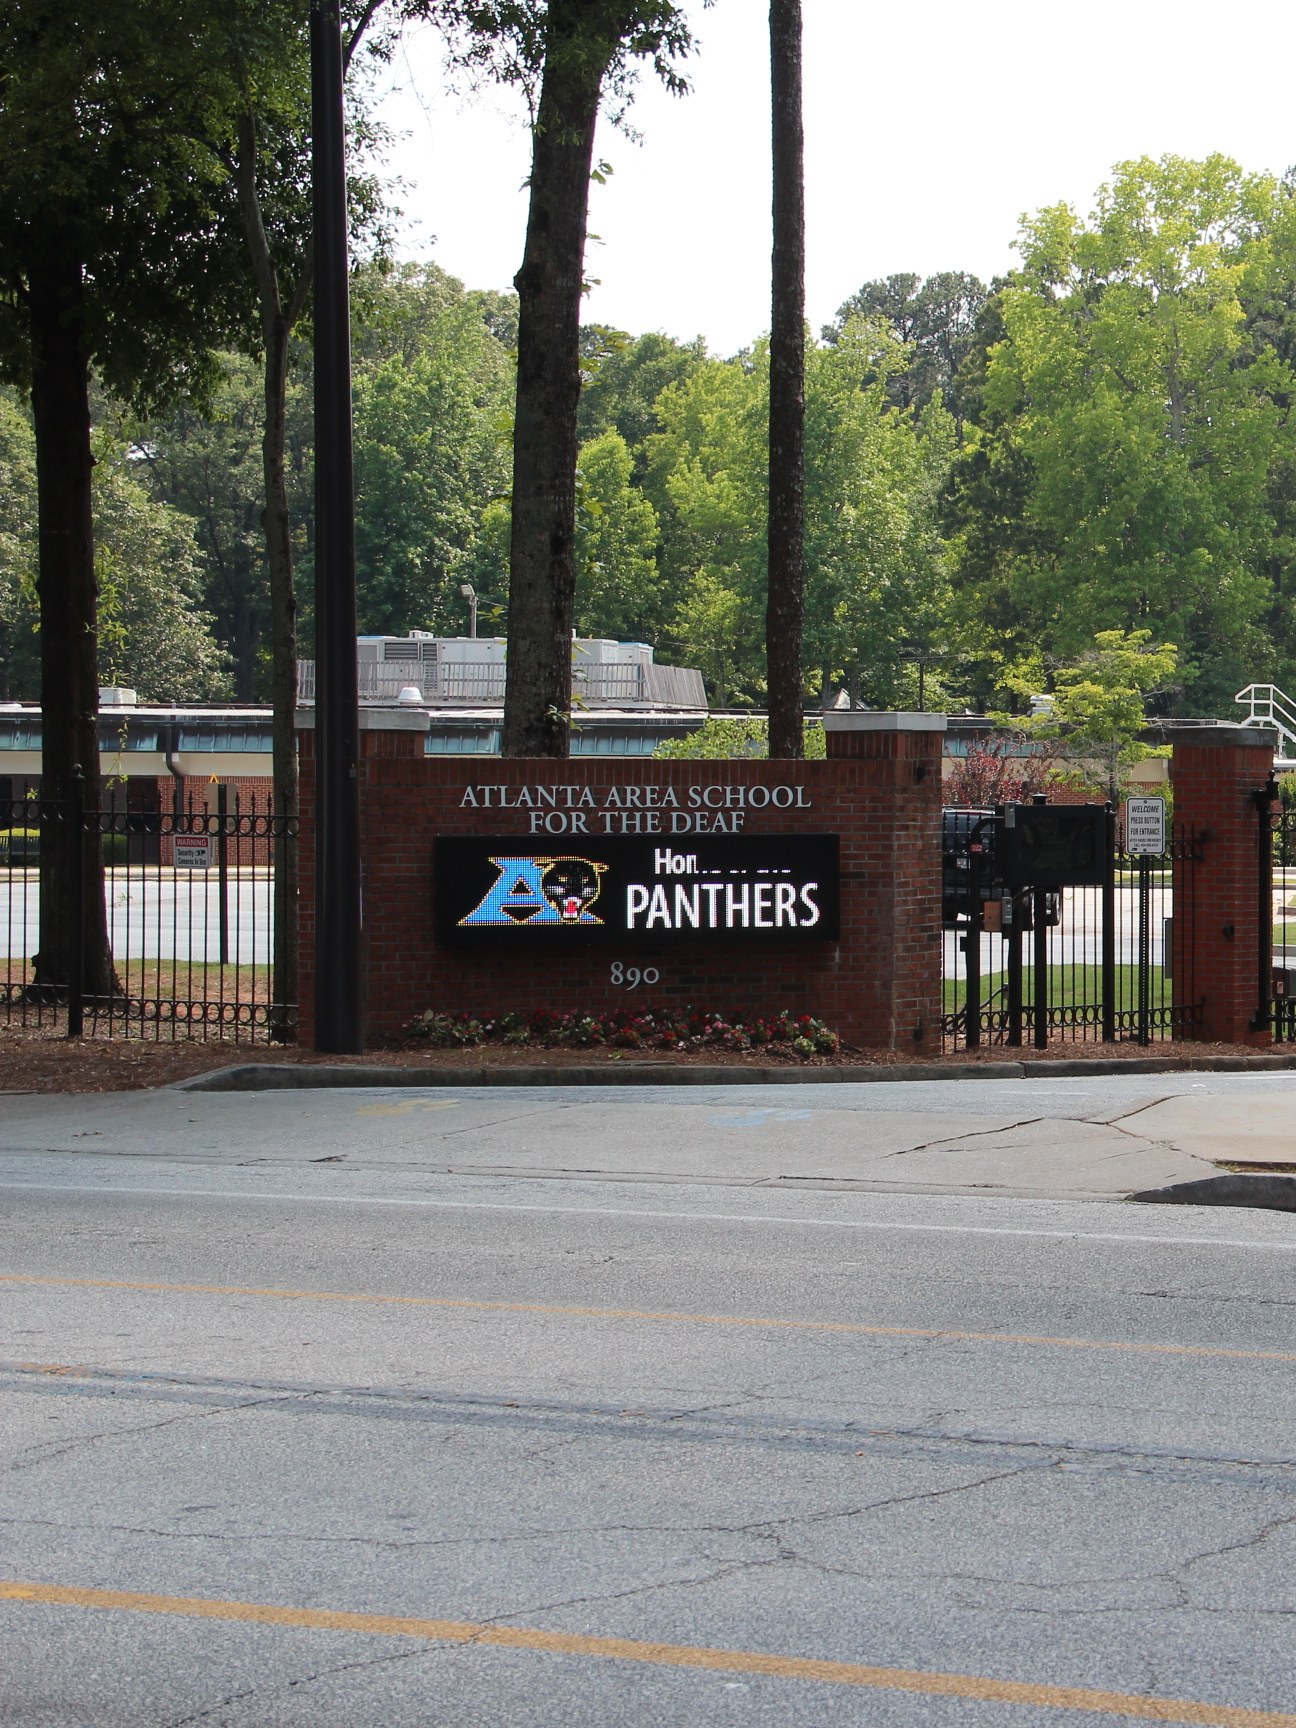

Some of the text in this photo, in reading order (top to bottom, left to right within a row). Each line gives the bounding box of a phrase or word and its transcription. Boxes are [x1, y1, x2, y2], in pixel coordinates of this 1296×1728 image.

[458, 784, 812, 808] ATLANTA AREA SCHOOL
[528, 811, 745, 834] FOR THE DEAF
[1130, 816, 1160, 824] PRESS BUTTON
[177, 838, 206, 846] WARNING
[1130, 828, 1160, 836] FOR ENTRANCE
[627, 882, 821, 929] PANTHERS
[610, 961, 660, 991] 890
